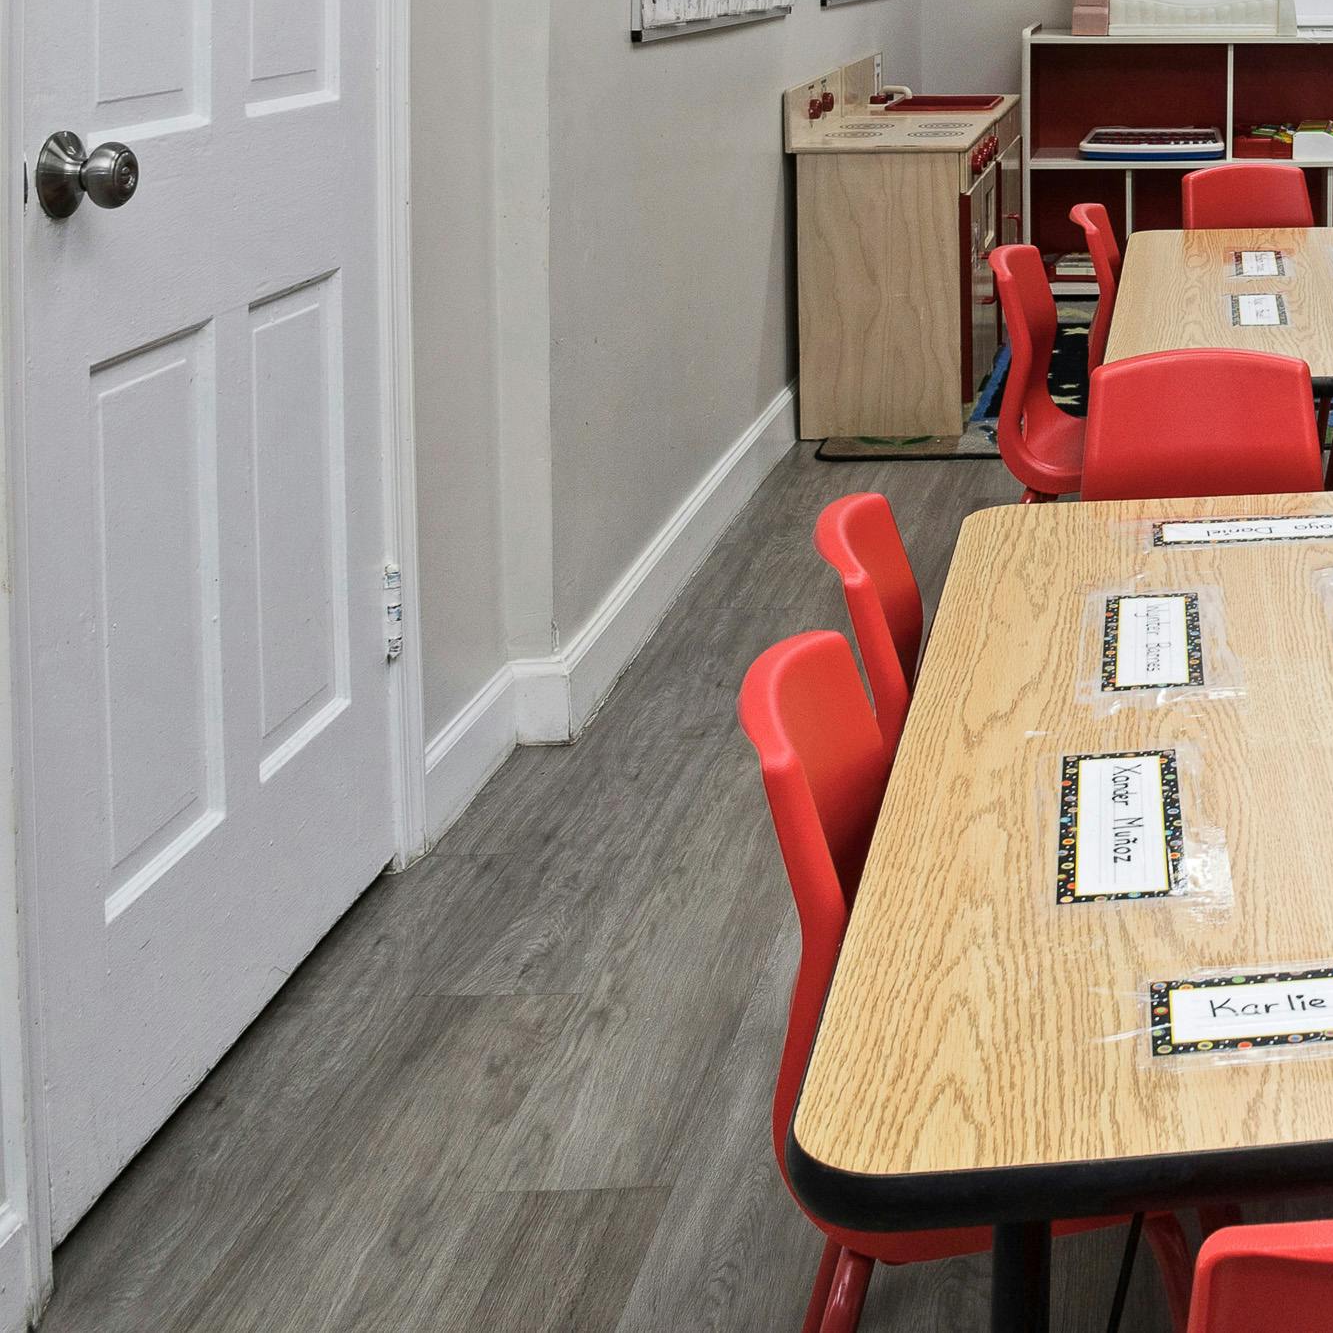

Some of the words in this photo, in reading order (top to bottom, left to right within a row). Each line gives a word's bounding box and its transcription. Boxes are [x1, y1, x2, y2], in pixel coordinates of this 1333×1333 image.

[1206, 525, 1274, 538] Daniel
[1134, 603, 1172, 636] Wynter
[1145, 641, 1172, 673] Barnes
[1111, 763, 1143, 807] Xander
[1112, 816, 1144, 864] Muñoz
[1209, 993, 1328, 1018] Karlie
